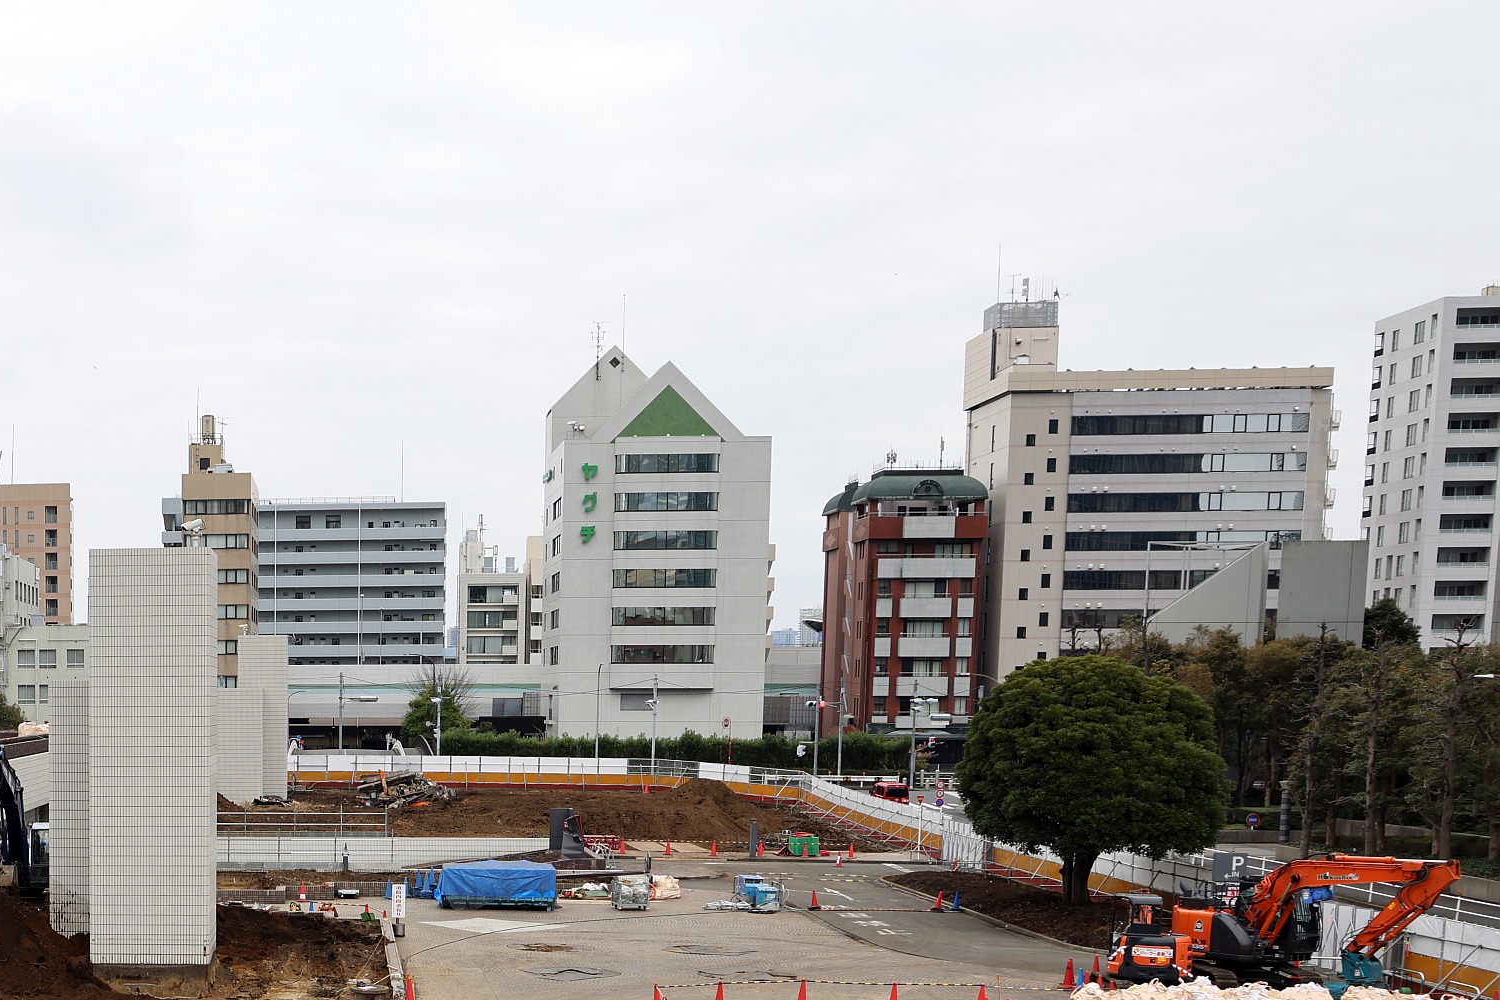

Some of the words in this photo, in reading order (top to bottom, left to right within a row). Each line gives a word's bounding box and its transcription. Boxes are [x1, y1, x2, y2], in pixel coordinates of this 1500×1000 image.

[580, 463, 598, 543] ヤグチ
[1232, 856, 1245, 871] P
